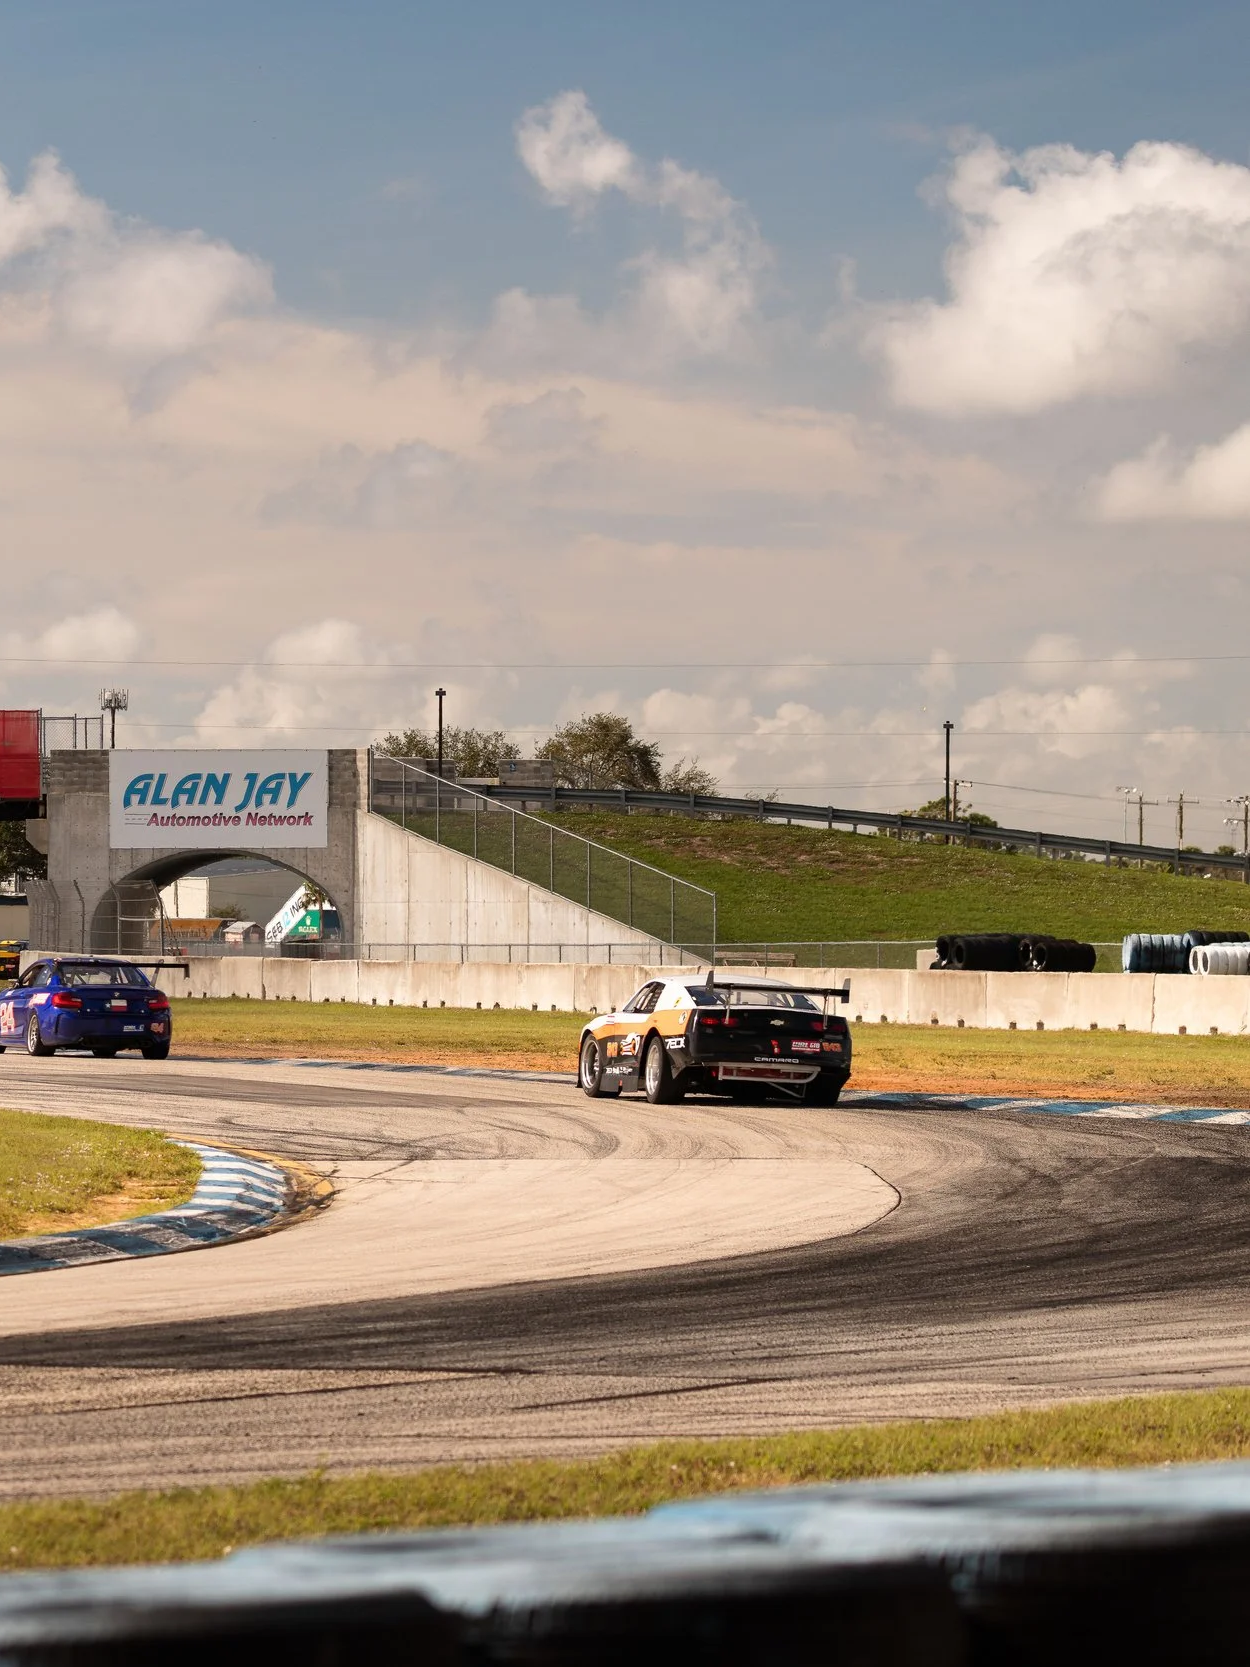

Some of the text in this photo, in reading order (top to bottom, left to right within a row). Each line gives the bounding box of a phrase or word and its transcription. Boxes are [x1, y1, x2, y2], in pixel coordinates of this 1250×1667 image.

[123, 772, 314, 814] ALAN JAY
[147, 812, 314, 827] Automotive Network
[754, 1056, 800, 1064] CAMARO
